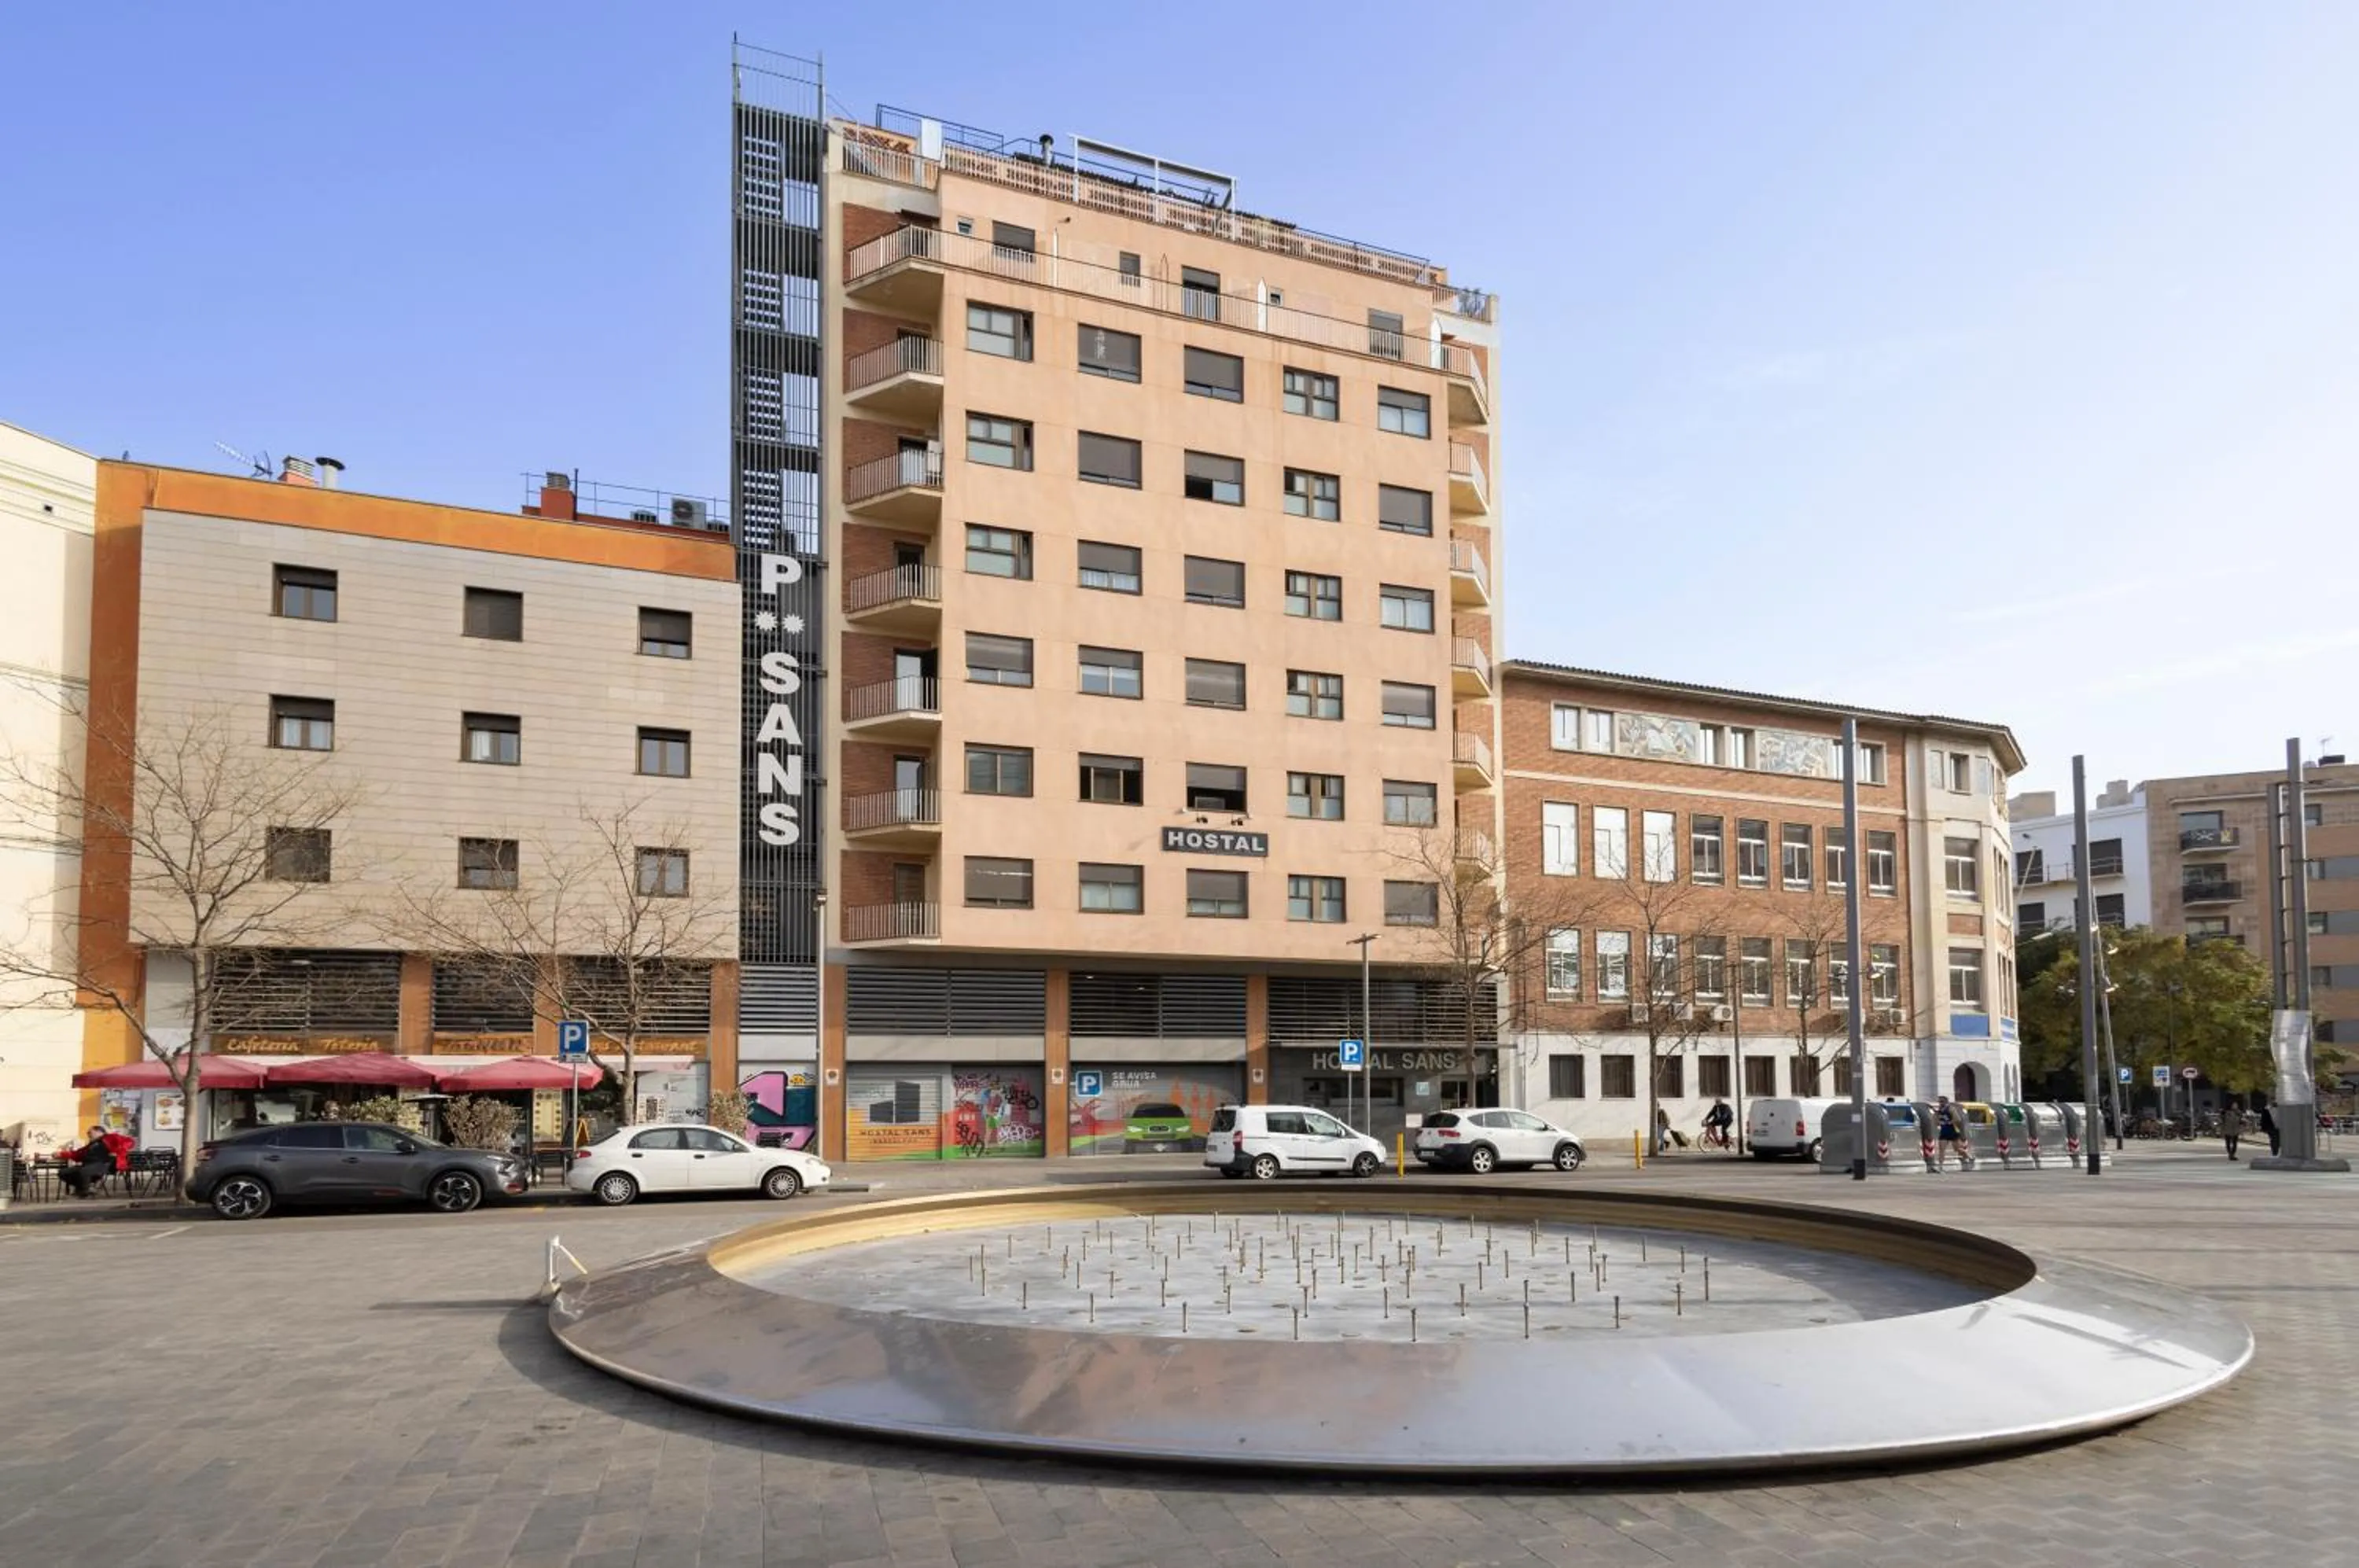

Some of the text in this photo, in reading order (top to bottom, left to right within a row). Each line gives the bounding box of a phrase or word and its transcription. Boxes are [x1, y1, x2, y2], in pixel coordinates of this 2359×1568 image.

[760, 554, 802, 595] P
[756, 652, 802, 846] SANS
[1168, 830, 1265, 852] HOSTAL
[564, 1025, 582, 1050] P
[1312, 1052, 1456, 1070] HOAL SANS
[1344, 1043, 1358, 1061] P
[1082, 1076, 1097, 1092] P
